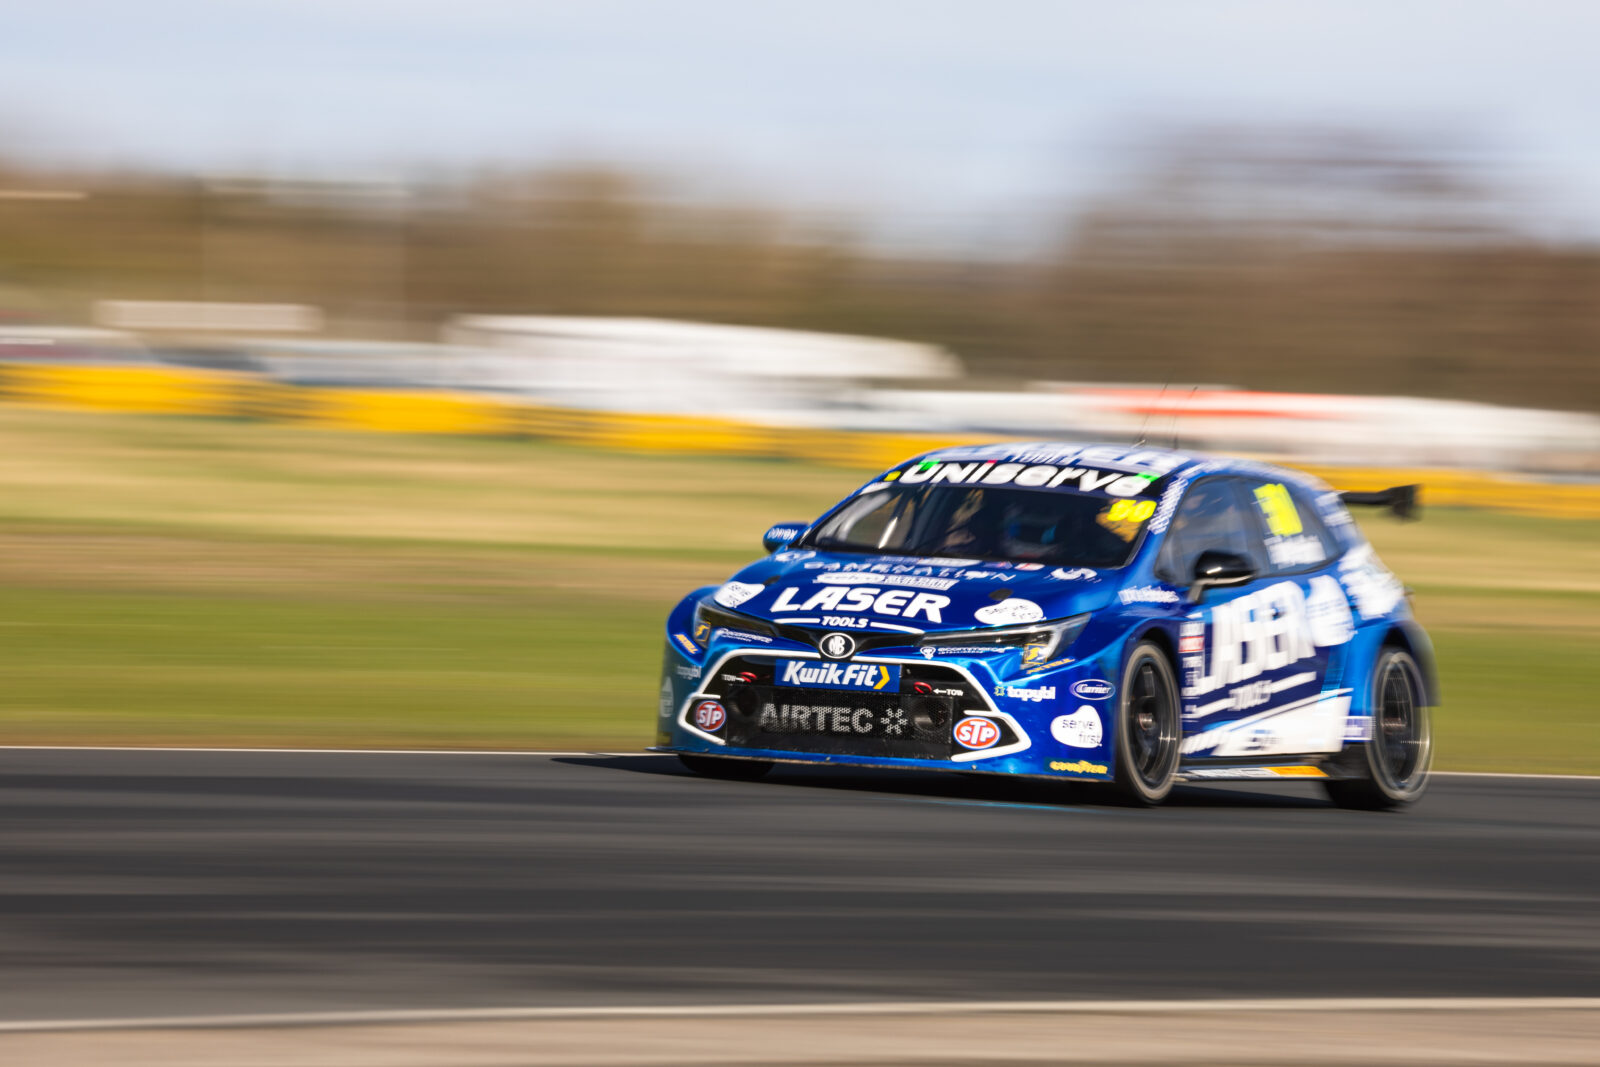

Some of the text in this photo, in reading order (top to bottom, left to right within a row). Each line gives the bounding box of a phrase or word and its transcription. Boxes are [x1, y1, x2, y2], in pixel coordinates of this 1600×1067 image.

[770, 586, 951, 624] LASER
[821, 616, 869, 629] TOOLS
[946, 688, 964, 697] TOW
[698, 704, 723, 727] STP
[759, 703, 874, 734] AIRTEC
[1062, 719, 1095, 730] serve
[958, 719, 996, 745] STP
